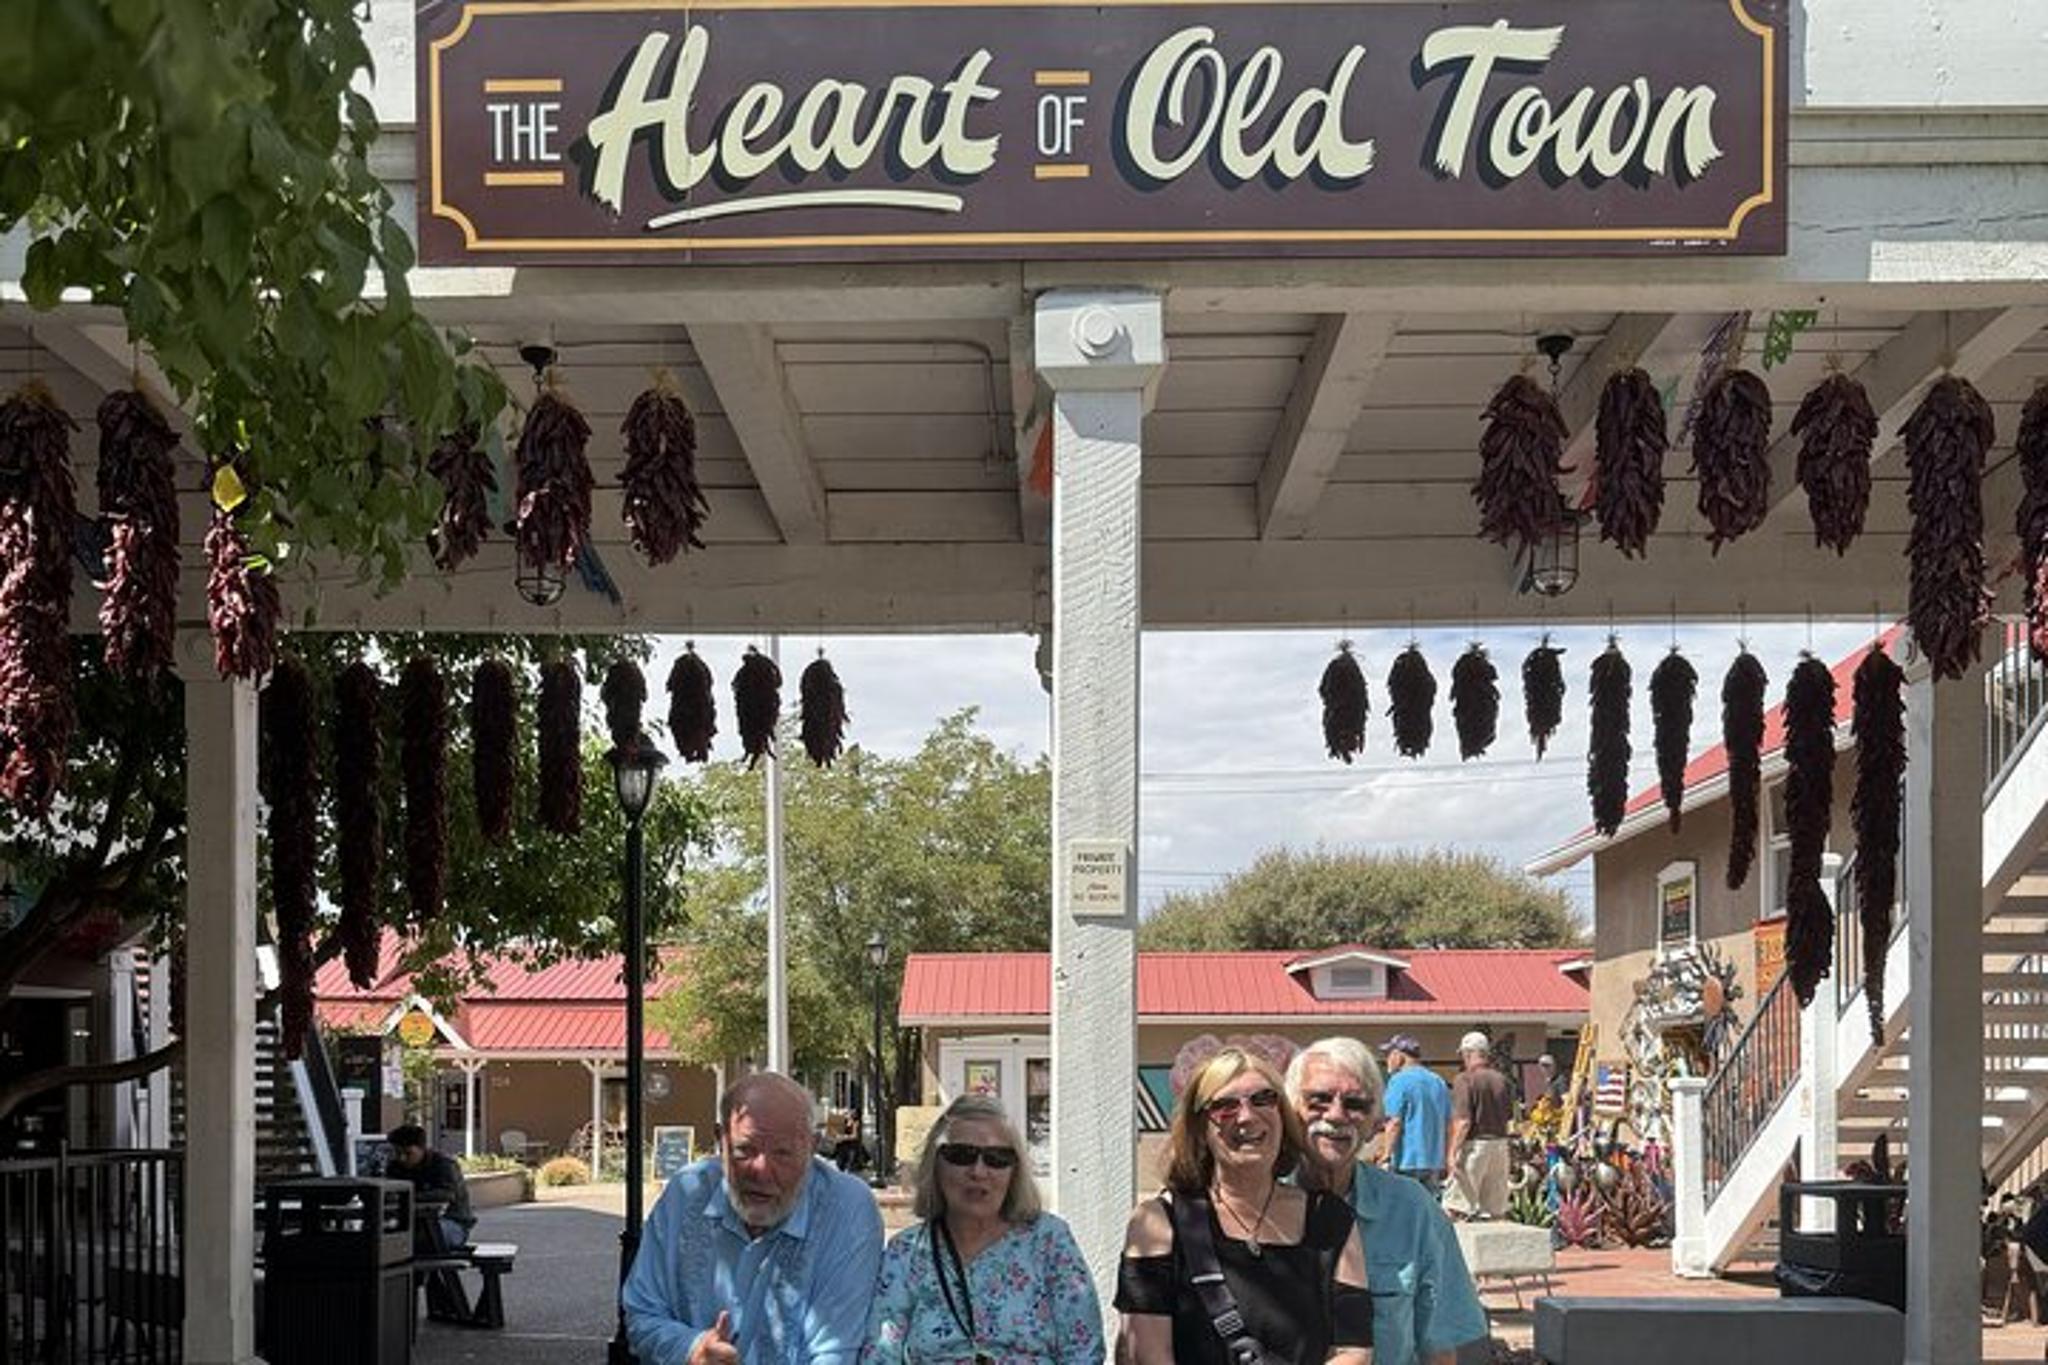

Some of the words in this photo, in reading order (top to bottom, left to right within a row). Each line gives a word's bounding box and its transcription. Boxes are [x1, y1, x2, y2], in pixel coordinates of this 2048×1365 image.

[486, 102, 562, 162] THE
[587, 24, 1001, 214] Heart
[1037, 94, 1088, 156] OF
[1125, 26, 1374, 180] Old
[1421, 18, 1723, 179] Town
[1071, 863, 1122, 875] PROPERTY
